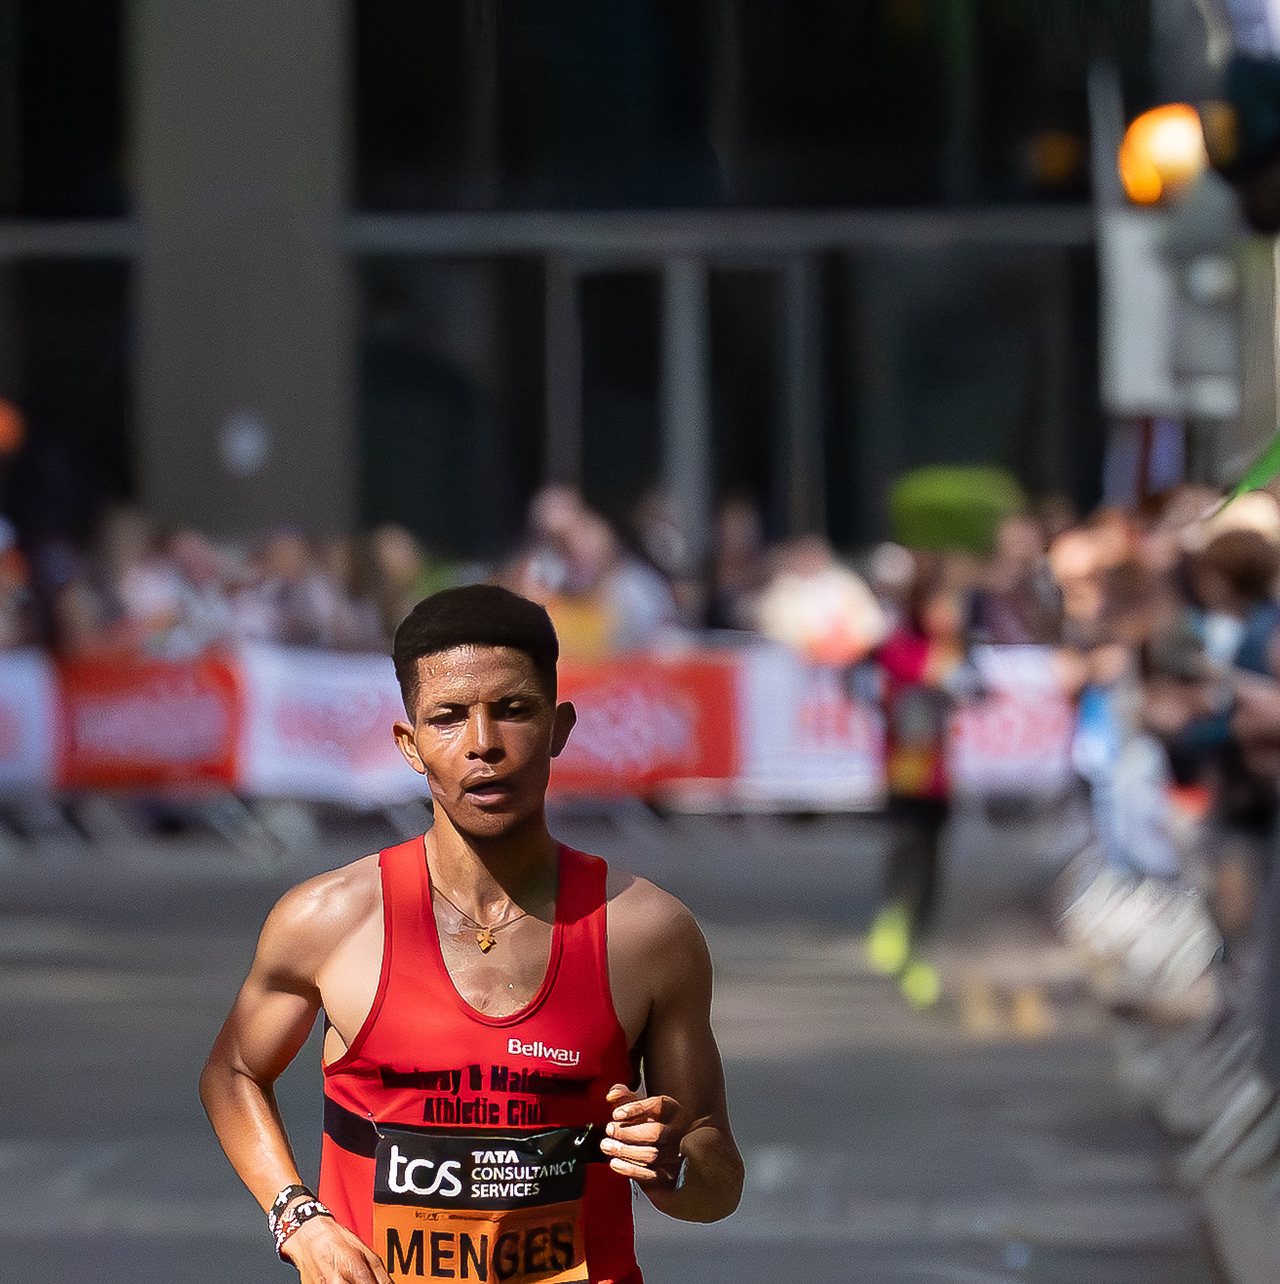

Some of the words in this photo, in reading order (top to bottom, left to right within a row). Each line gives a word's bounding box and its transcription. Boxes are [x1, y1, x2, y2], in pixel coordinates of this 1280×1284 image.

[508, 1039, 581, 1065] Bellway
[471, 1150, 519, 1164] TATA
[388, 1145, 462, 1197] tcs
[471, 1159, 577, 1180] CONSULTANCY
[471, 1183, 540, 1198] SERVICES
[386, 1223, 575, 1282] MENGES
